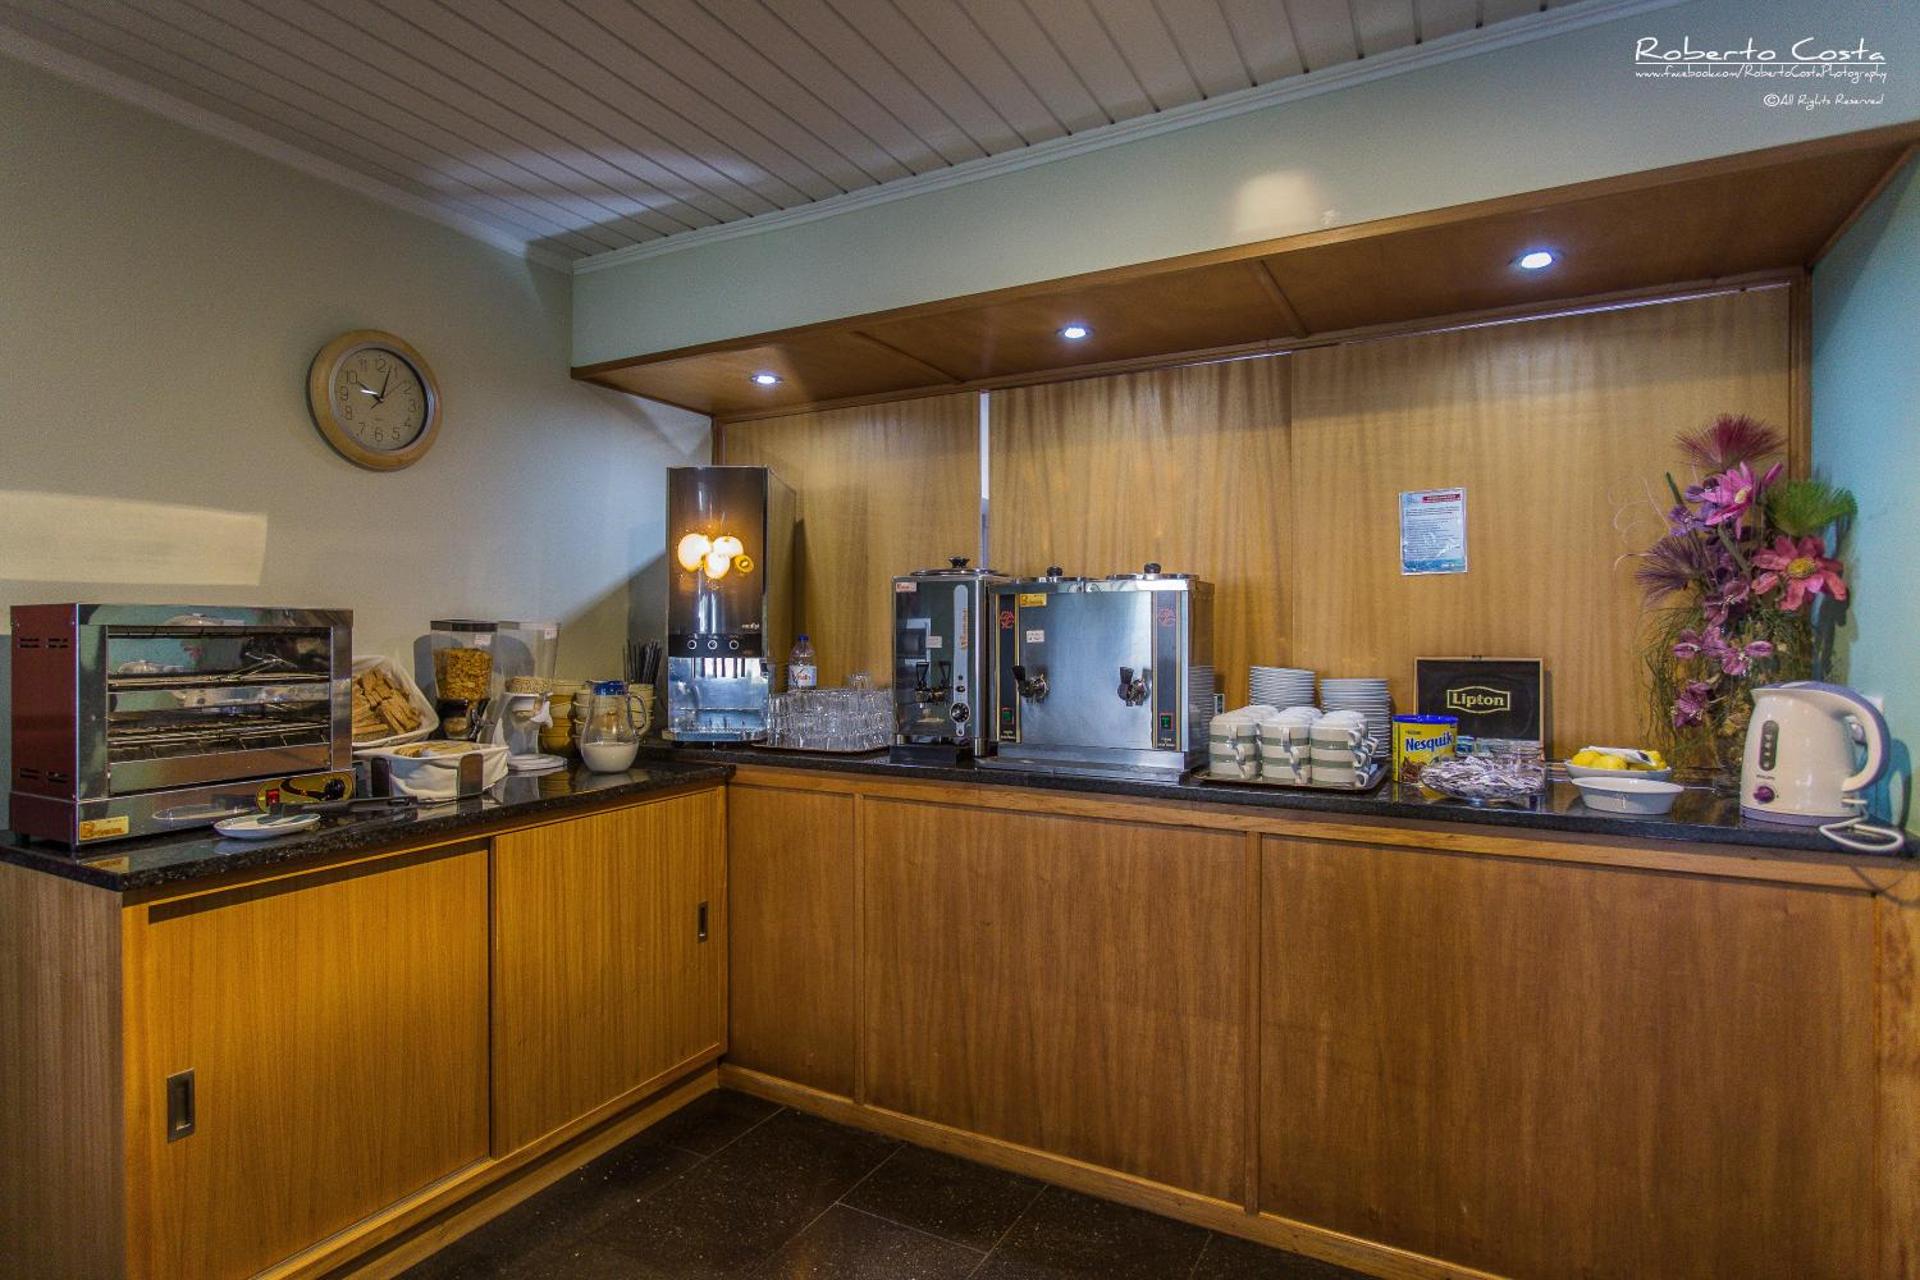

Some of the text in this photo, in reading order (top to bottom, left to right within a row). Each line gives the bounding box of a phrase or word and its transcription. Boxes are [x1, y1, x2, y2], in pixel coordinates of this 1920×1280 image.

[376, 358, 386, 374] 12
[345, 368, 358, 385] 10
[408, 399, 417, 413] 3
[358, 422, 366, 435] 7
[374, 426, 384, 442] 6
[392, 425, 401, 441] 5
[1452, 693, 1505, 708] Lipton
[1405, 731, 1454, 752] Nesquik
